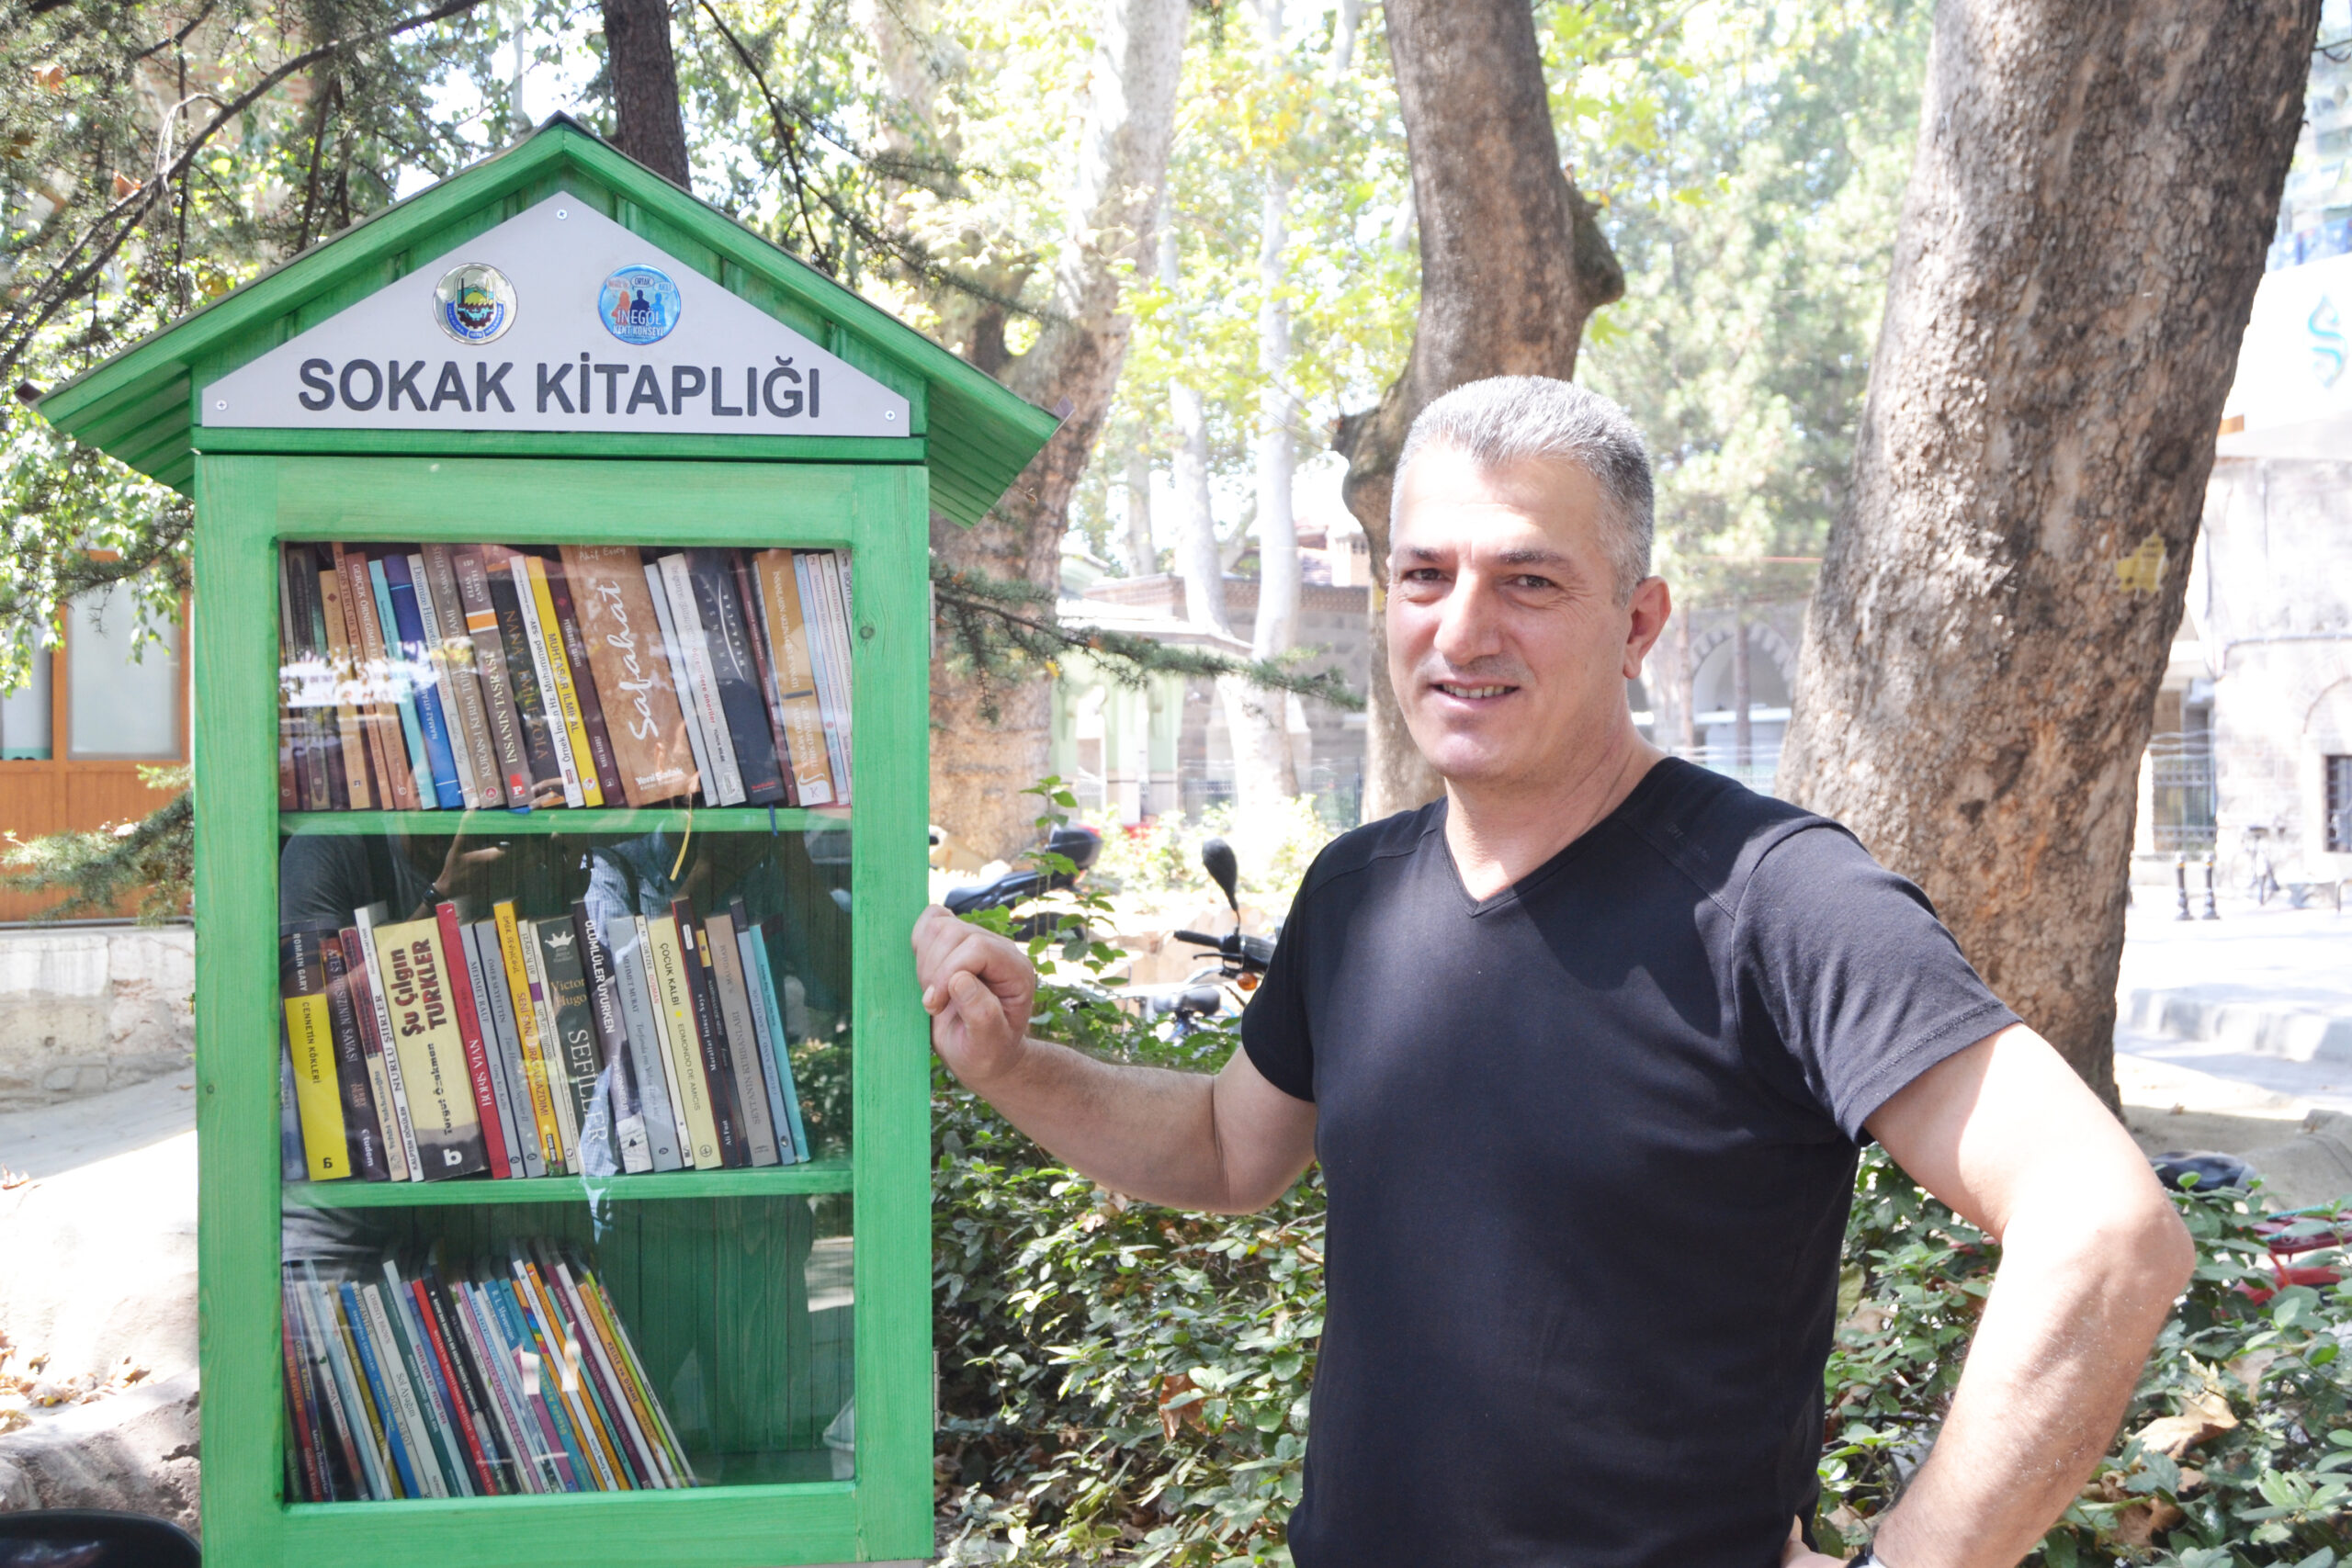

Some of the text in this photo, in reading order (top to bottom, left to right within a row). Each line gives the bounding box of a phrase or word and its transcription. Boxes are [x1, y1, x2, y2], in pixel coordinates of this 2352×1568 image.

[616, 307, 662, 325] İNEGÖL
[299, 353, 820, 418] SOKAK KİTAPLIĞI
[351, 564, 377, 645] GERÇEK ÖRNEĞİMİZ
[413, 566, 429, 605] Dinimize
[465, 577, 474, 598] ELIAS
[469, 569, 483, 602] CANETTI
[503, 608, 525, 656] NANA
[702, 582, 732, 684] EVRENSEL
[718, 593, 749, 666] MESAJLAR
[532, 639, 553, 694] Muhammed
[547, 632, 569, 689] MUHTASAR
[597, 580, 660, 740] Safahat
[483, 650, 516, 763] İNSANIN TAŞRASI
[547, 694, 556, 708] Hz.
[528, 716, 549, 759] ZOLA
[557, 736, 570, 762] Örnek
[292, 933, 307, 992] ROMAIN GARY
[486, 958, 498, 984] ÖMER
[582, 918, 616, 1033] ÖLÜMLÜLER UYURKEN
[640, 941, 653, 971] COETZEE
[659, 942, 680, 1006] ÇOCUK KALBİ
[718, 943, 733, 985] MAUGHAM
[388, 948, 426, 1038] Şu Çılgın
[469, 961, 489, 1024] MEHMET RAUF
[516, 991, 528, 1013] SENİ
[549, 973, 586, 994] Victor
[553, 988, 588, 1010] Hugo
[621, 954, 639, 1014] MEHMET MURAT
[696, 992, 706, 1011] Suya
[327, 947, 357, 1064] ATEŞ HIRSIZININ SAVAŞI
[302, 1001, 320, 1084] CENNETİN KÖKLERİ
[705, 1038, 718, 1071] Marallar
[729, 1010, 752, 1075] KURBANLARI
[386, 1045, 401, 1091] NURLU
[468, 1038, 492, 1107] BORIS VIAN
[564, 1027, 613, 1144] SEFİLLER
[677, 1022, 700, 1111] EDMONDO DE AMICIS
[398, 1105, 411, 1138] DÖKÜLEN
[435, 1097, 454, 1135] Turgut
[720, 1118, 732, 1145] Ali Fuat
[362, 1135, 375, 1167] tudem
[405, 1139, 418, 1170] KALPTEN
[496, 1306, 517, 1340] Stevenson
[605, 1340, 622, 1366] KELİLE
[396, 1371, 406, 1385] Sol
